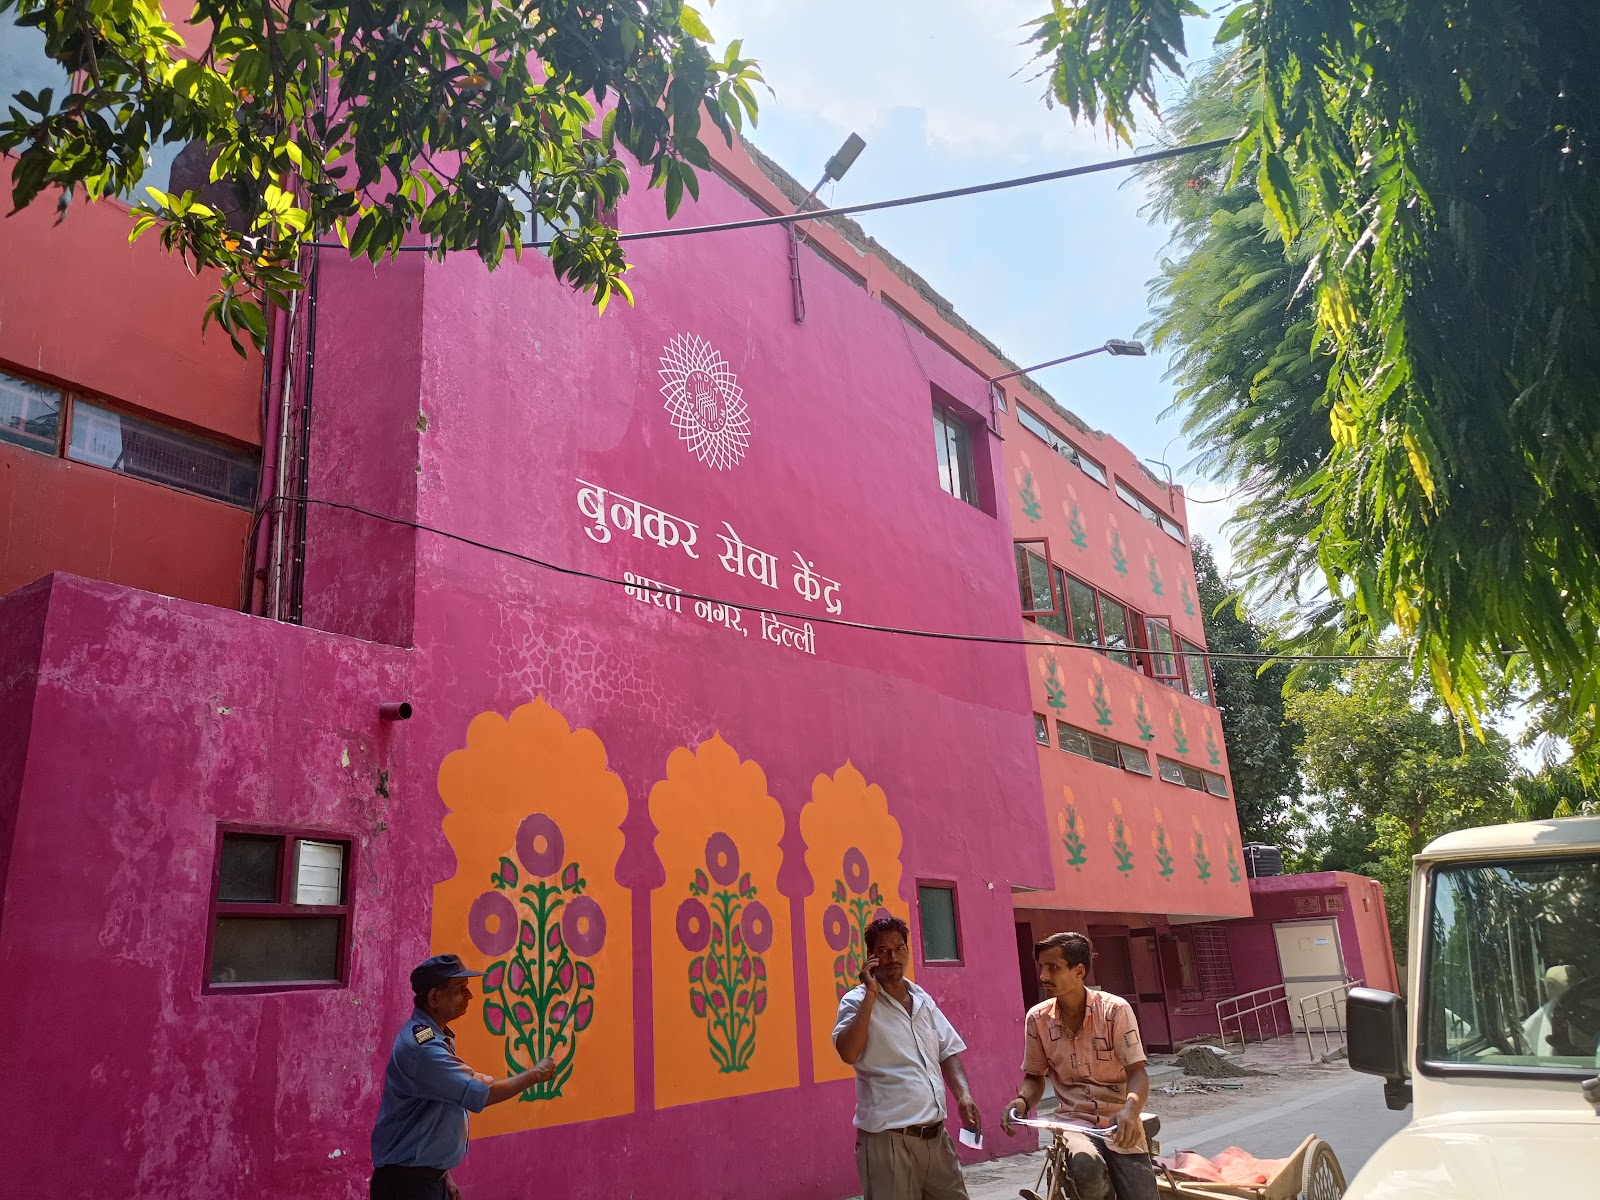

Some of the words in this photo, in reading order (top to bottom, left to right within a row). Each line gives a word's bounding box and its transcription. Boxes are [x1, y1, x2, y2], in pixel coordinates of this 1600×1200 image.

[686, 391, 726, 431] HANDLOOM
[692, 372, 719, 395] INDIA
[575, 477, 699, 559] बुनकर
[716, 520, 779, 590] सेवा
[791, 550, 842, 615] केंद्र
[623, 571, 682, 614] भारत
[694, 594, 748, 637] नगर,
[760, 608, 816, 655] दिल्ली
